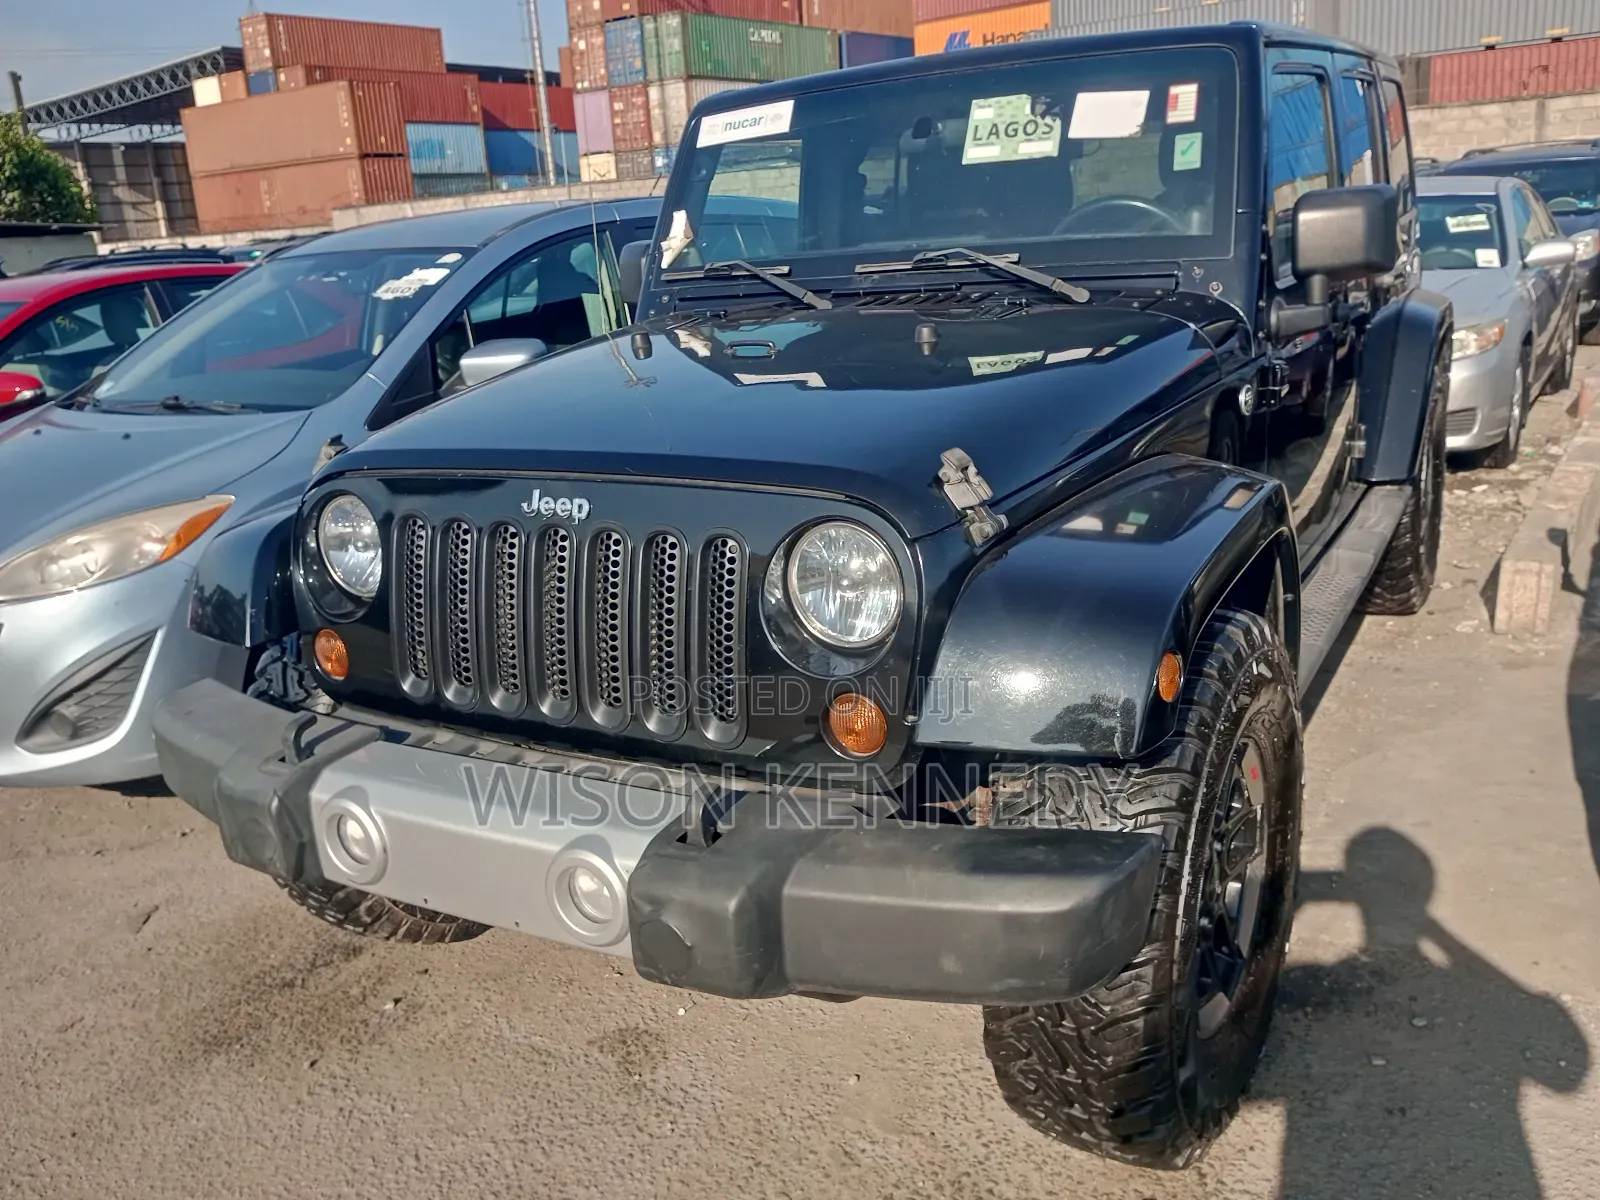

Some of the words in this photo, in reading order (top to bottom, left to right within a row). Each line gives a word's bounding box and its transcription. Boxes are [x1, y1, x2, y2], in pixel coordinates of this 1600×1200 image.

[724, 115, 764, 132] nucar
[972, 119, 1054, 141] LAGOS
[521, 488, 591, 525] Jeep
